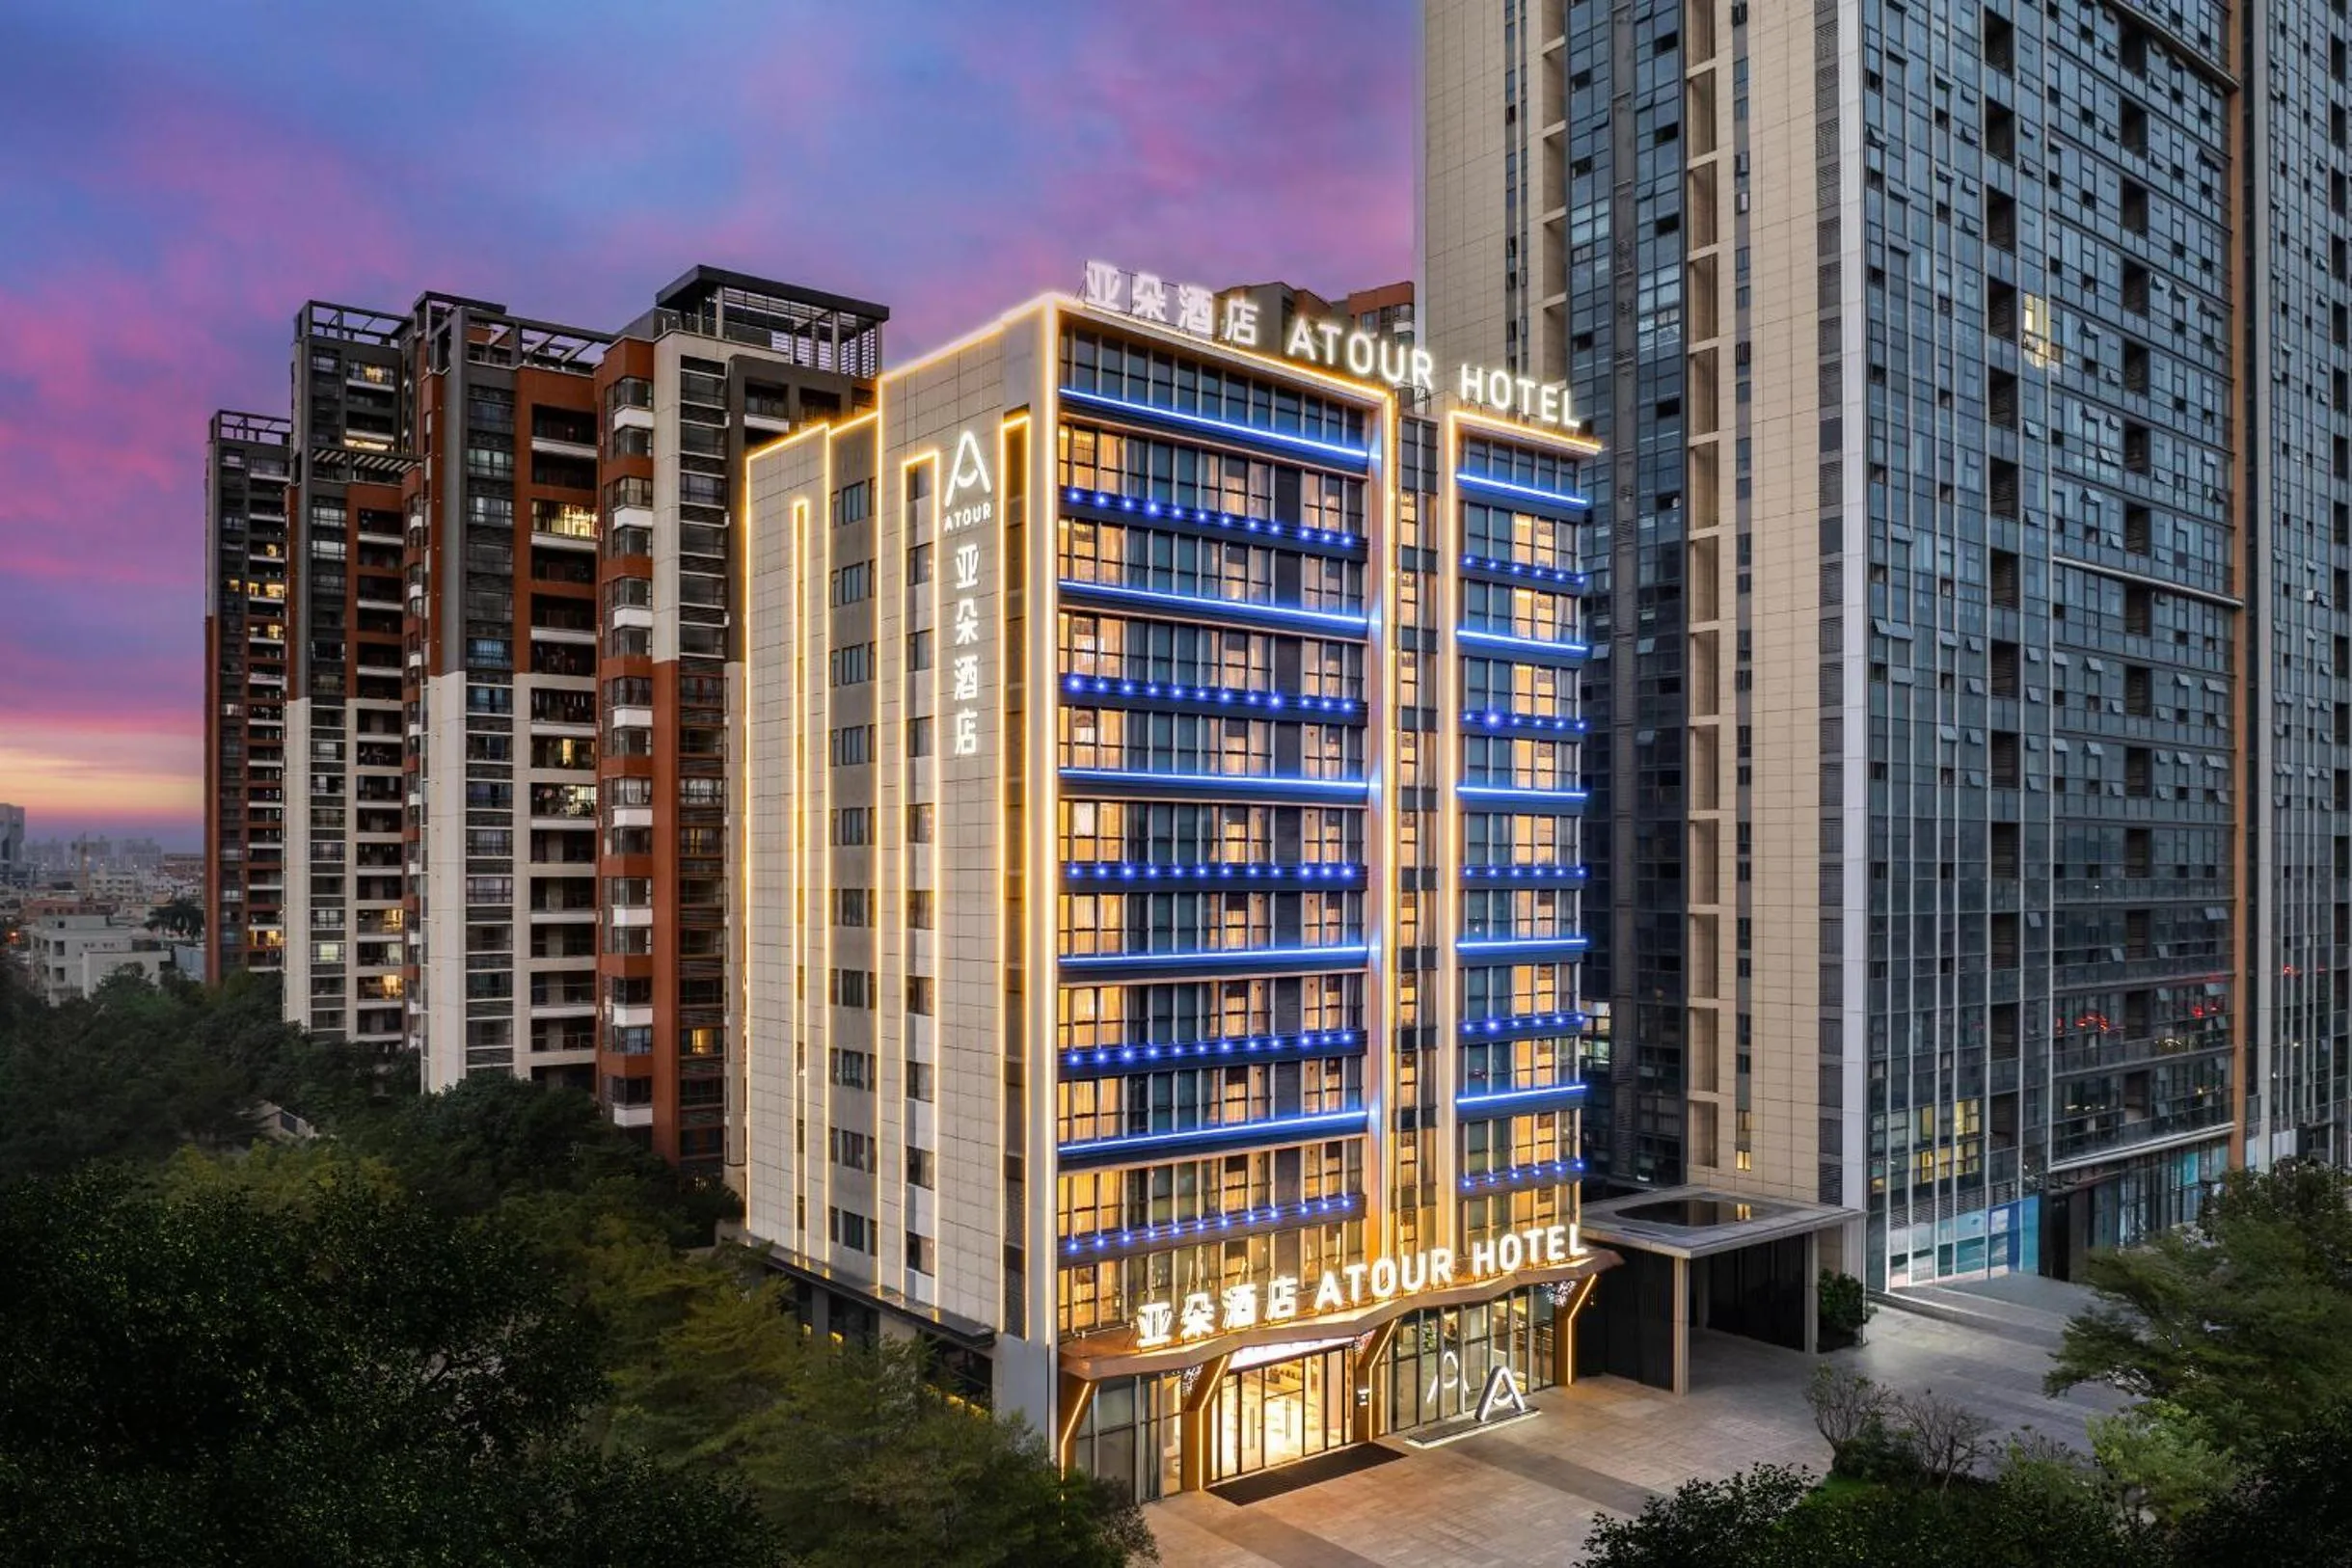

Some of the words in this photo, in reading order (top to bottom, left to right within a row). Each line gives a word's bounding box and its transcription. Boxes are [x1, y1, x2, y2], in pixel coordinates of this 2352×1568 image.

[1084, 261, 1258, 345] 亚朵酒店
[1286, 312, 1434, 389] ATOUR
[1461, 365, 1580, 428] HOTEL
[943, 501, 992, 532] ATOUR
[954, 543, 980, 756] 亚朵酒店
[1314, 1248, 1452, 1310] ATOUR
[1472, 1224, 1588, 1276] HOTEL
[1136, 1277, 1299, 1347] 亚朵酒店
